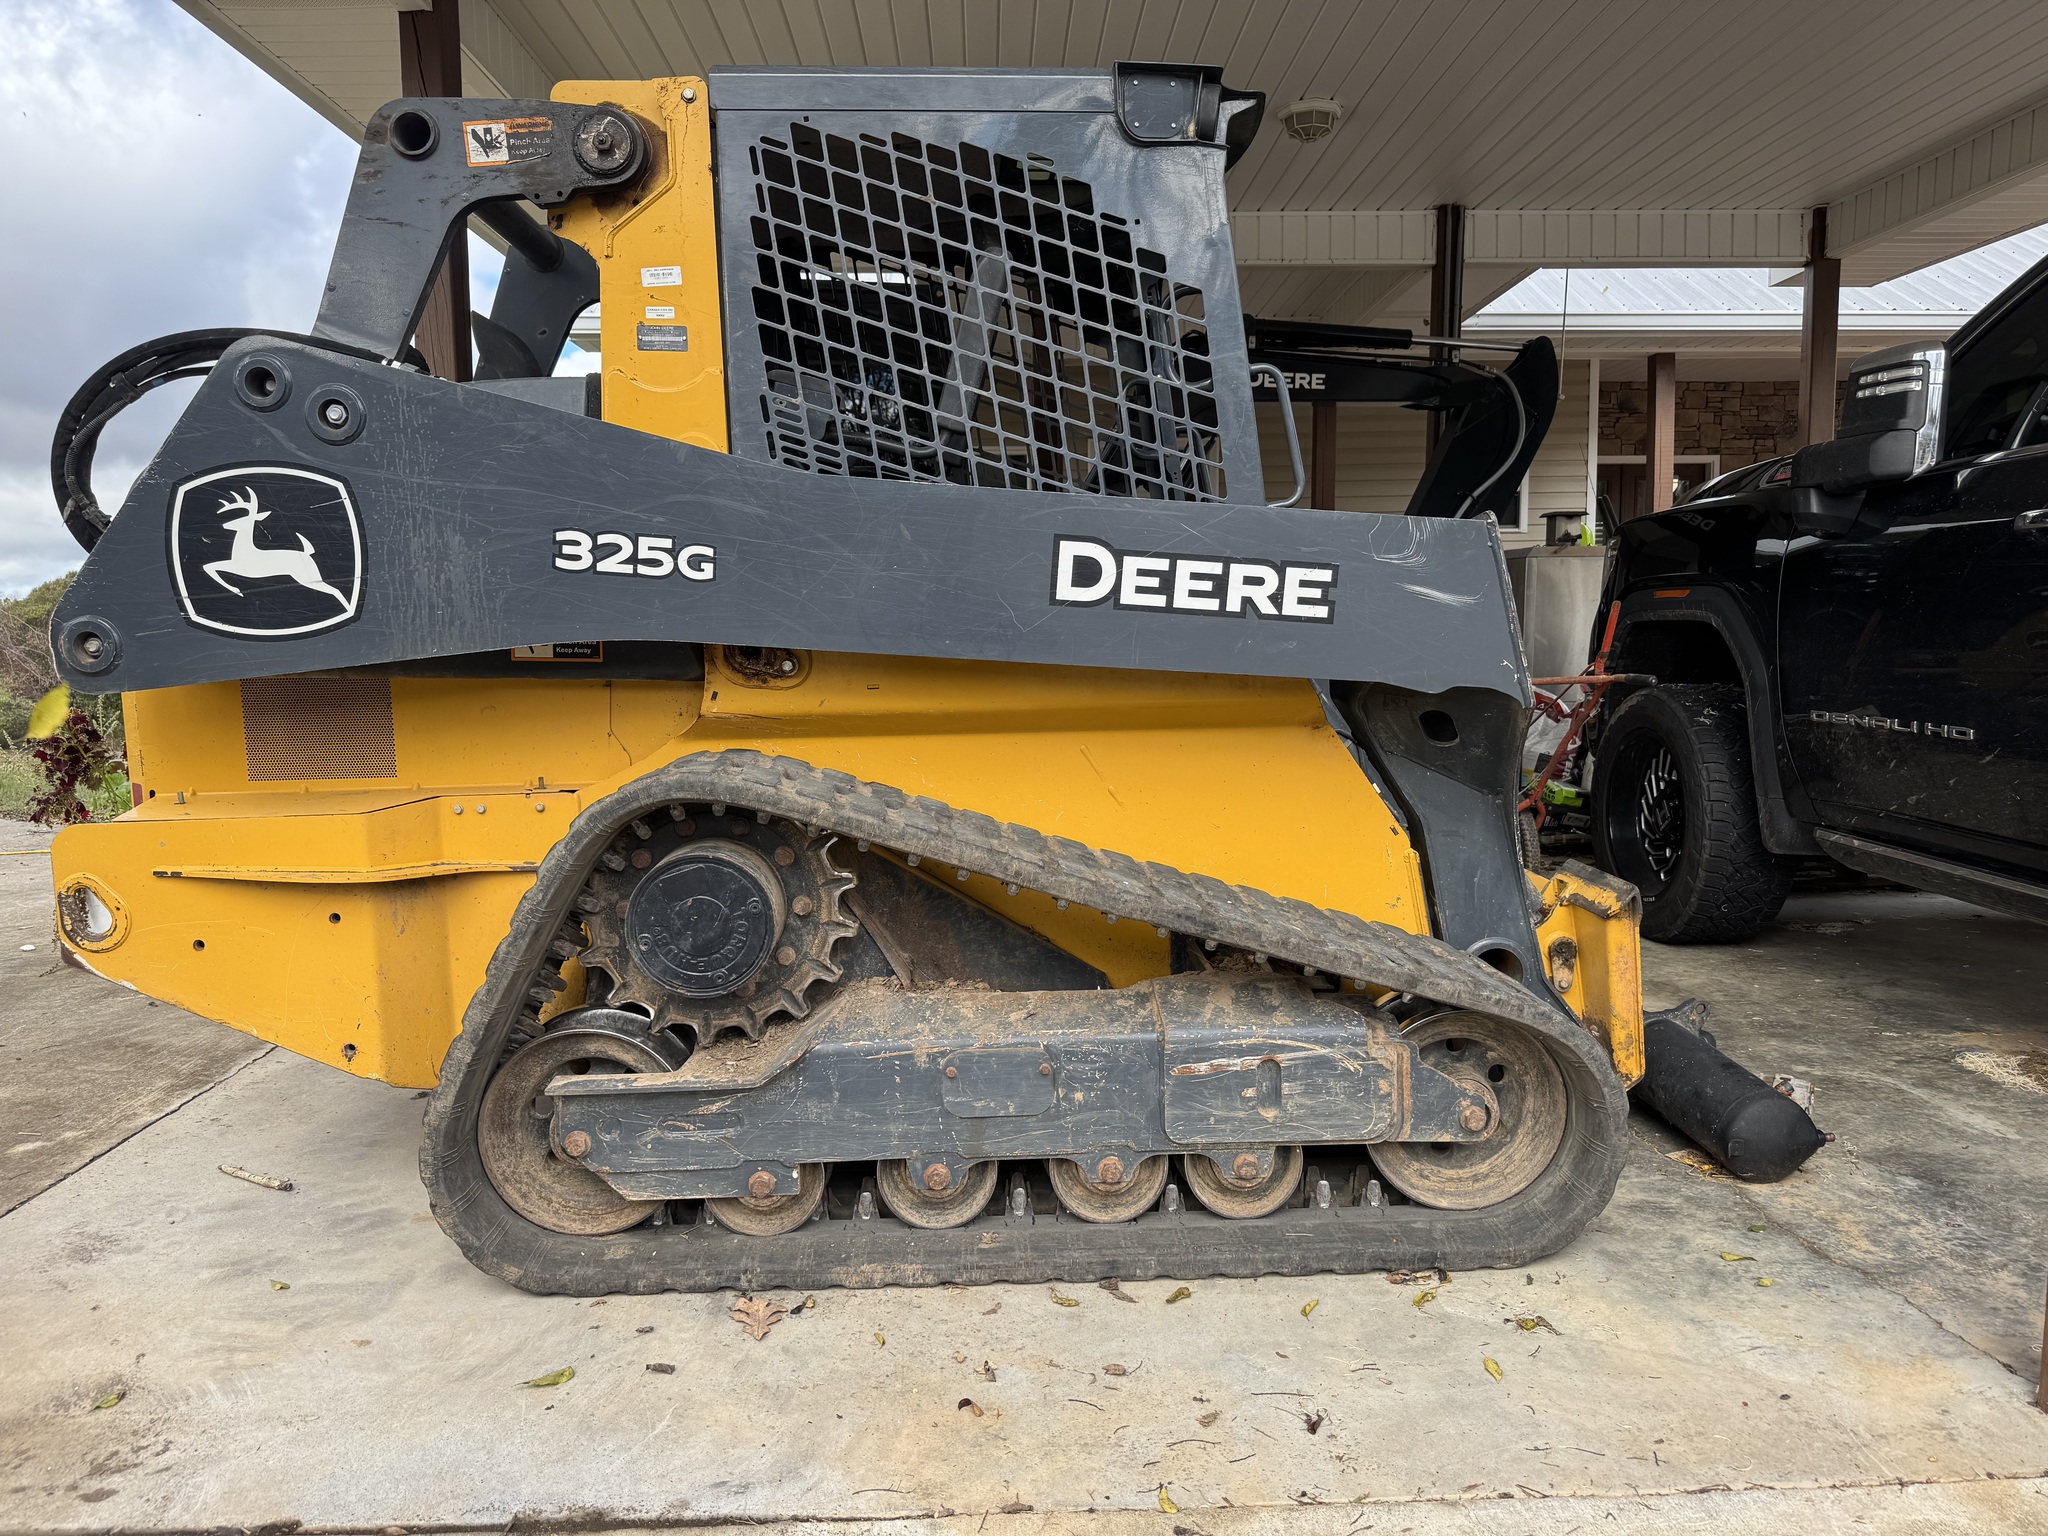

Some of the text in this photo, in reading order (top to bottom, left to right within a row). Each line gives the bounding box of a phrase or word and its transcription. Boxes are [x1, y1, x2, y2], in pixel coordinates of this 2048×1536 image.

[509, 138, 531, 146] Pinch
[555, 530, 714, 580] 325G
[1056, 540, 1333, 618] DEERE
[1810, 710, 1976, 740] DENALI HD
